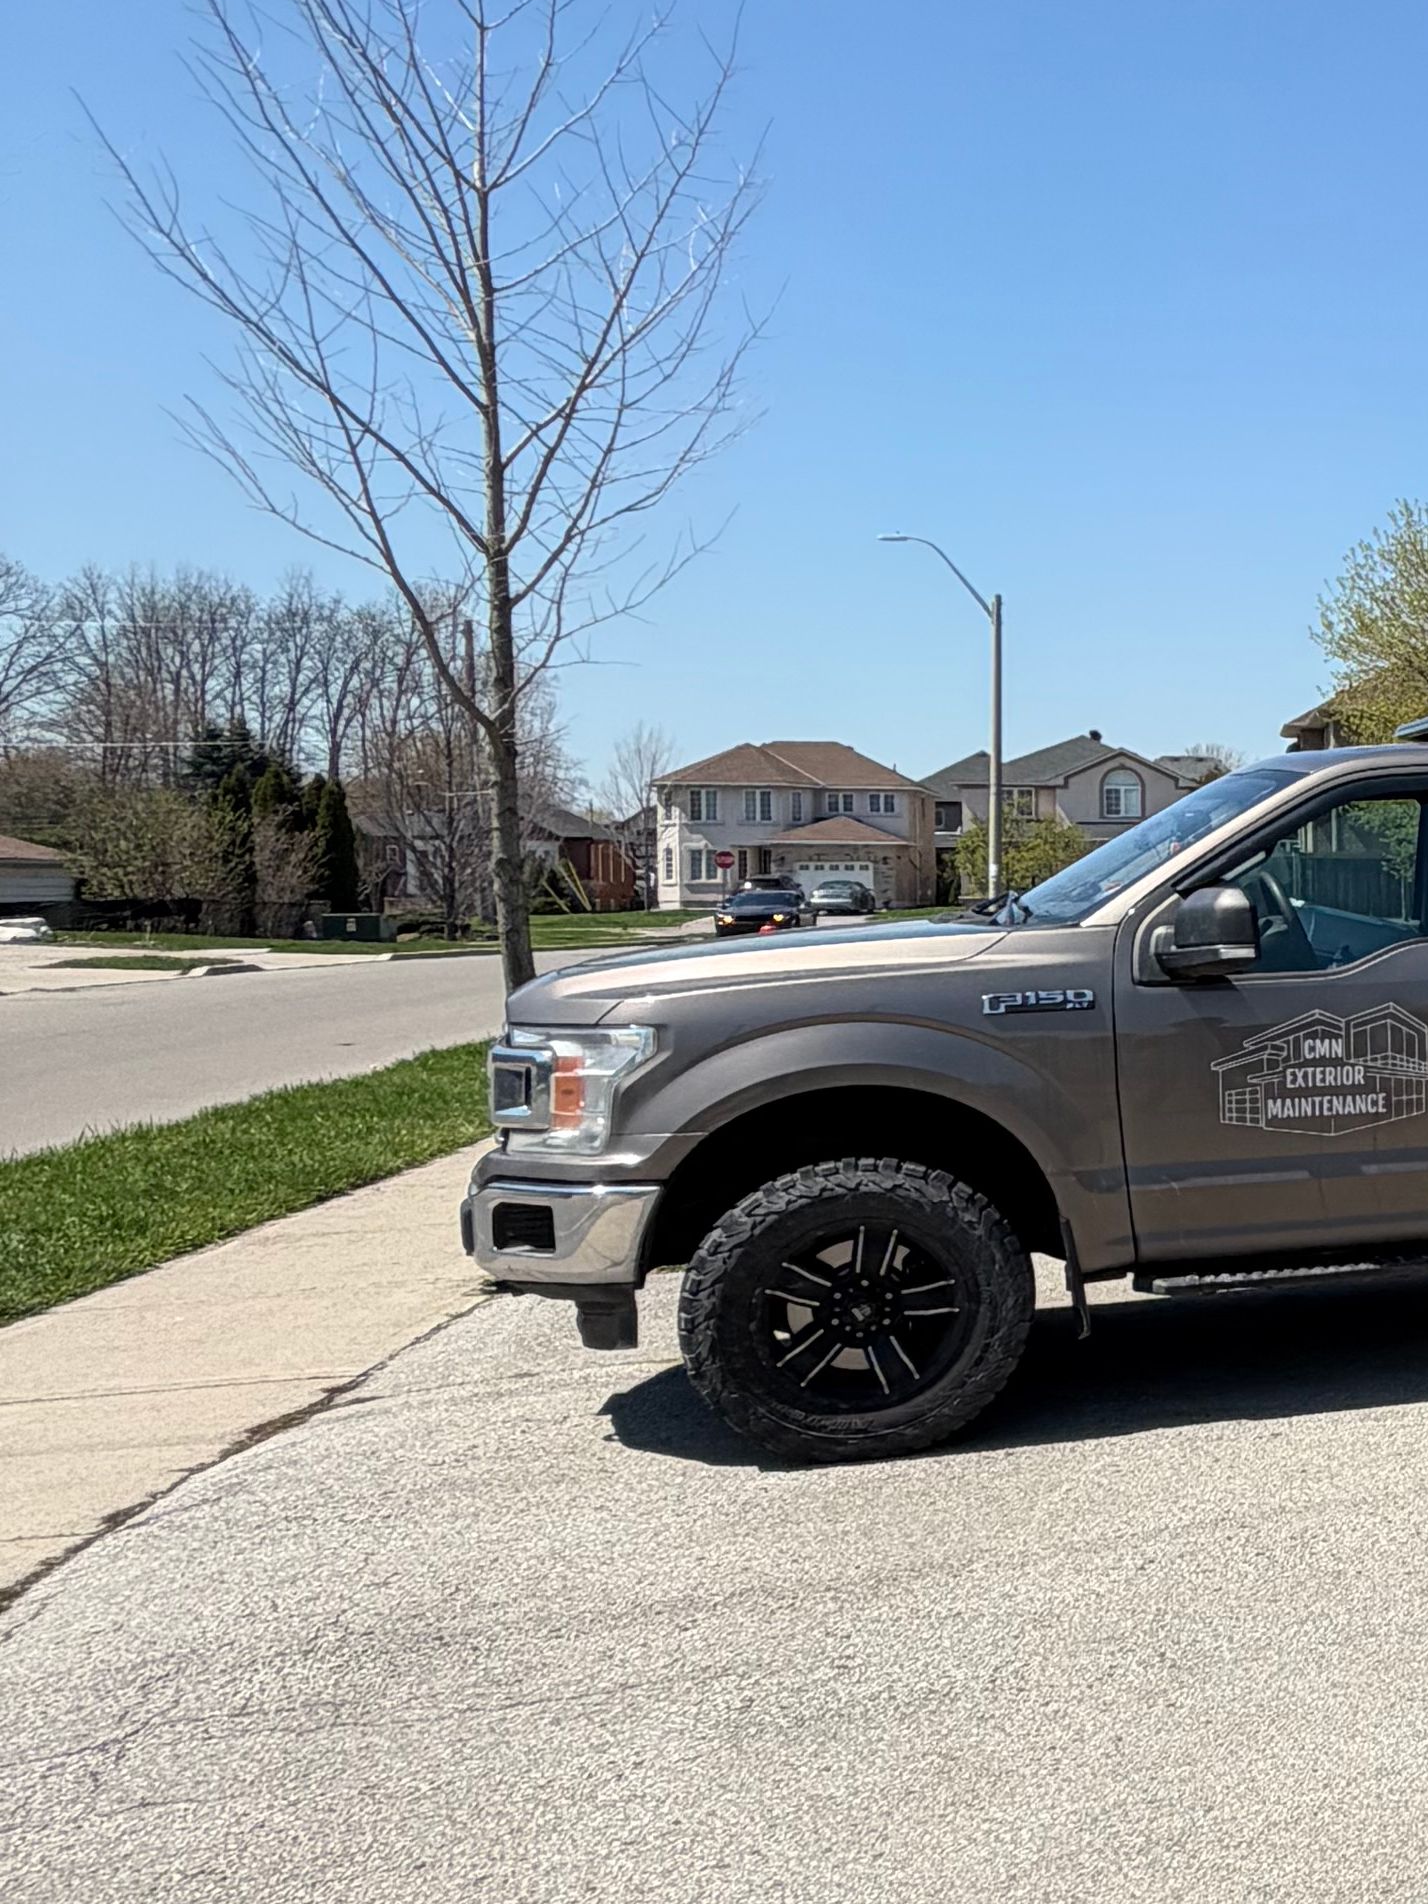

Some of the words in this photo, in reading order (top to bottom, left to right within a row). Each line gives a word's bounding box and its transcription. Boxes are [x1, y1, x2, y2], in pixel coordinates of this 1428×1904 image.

[1303, 1038, 1343, 1060] CMN
[1285, 1065, 1366, 1089] EXTERIOR
[1267, 1092, 1387, 1120] MAINTENANCE
